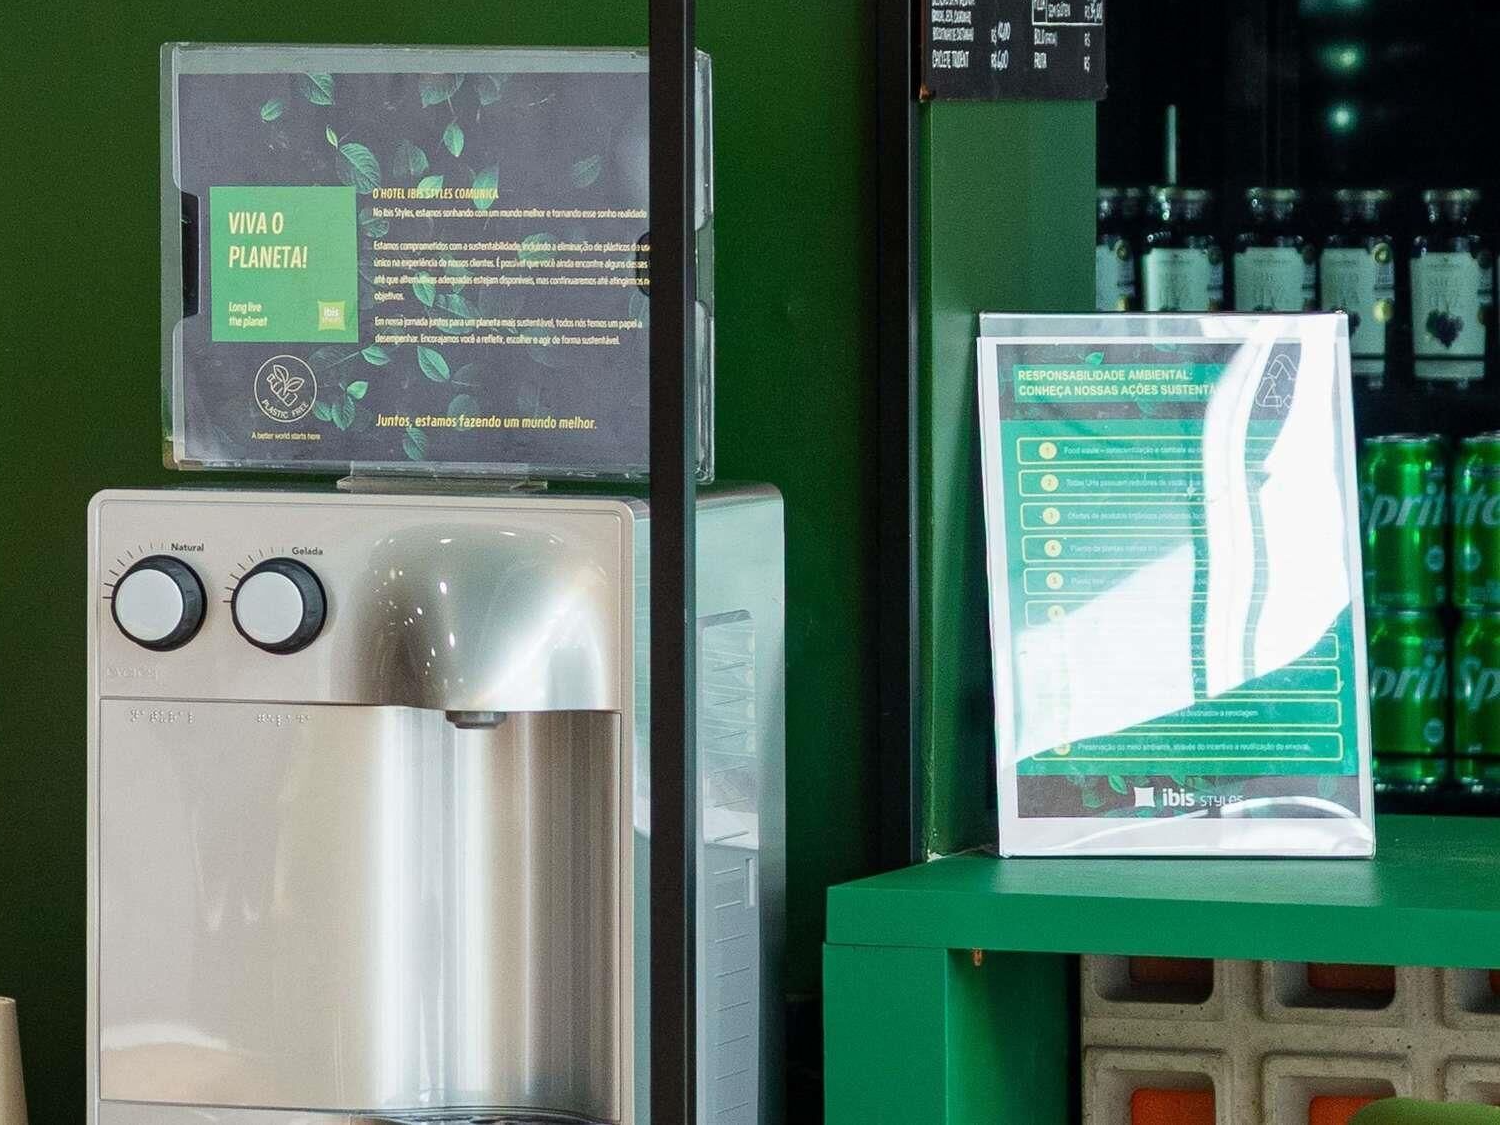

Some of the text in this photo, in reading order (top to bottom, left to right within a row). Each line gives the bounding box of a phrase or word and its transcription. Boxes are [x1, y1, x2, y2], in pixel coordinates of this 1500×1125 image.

[380, 188, 405, 199] HOTEL
[454, 188, 499, 200] COMUNICA
[372, 209, 383, 218] No
[415, 209, 442, 218] estamos
[442, 209, 475, 218] sonhando
[475, 210, 489, 218] com
[489, 210, 499, 218] um
[499, 209, 522, 218] mundo
[523, 208, 546, 218] melhor
[596, 209, 617, 218] sonho
[228, 212, 284, 235] VIVA O
[373, 241, 400, 251] Estamos
[400, 241, 449, 255] comprometidos
[449, 243, 463, 251] com
[228, 246, 309, 268] PLANETA!
[526, 260, 540, 270] que
[540, 258, 556, 268] você
[536, 276, 550, 285] mas
[228, 302, 262, 315] Long live
[228, 315, 268, 328] the planet
[404, 316, 429, 328] jornada
[476, 317, 501, 329] planeta
[607, 320, 619, 328] um
[619, 318, 637, 330] papel
[460, 334, 476, 343] você
[1018, 369, 1193, 381] RESPONSABILIDADE AMBIENTAL:
[1019, 383, 1159, 398] CONHEÇA NOSSAS AÇÕES
[261, 399, 289, 419] PLASTIC
[375, 414, 597, 429] Juntos, estamos fazendo um mundo melhor.
[171, 544, 204, 552] Natural
[292, 547, 324, 555] Gelada
[1162, 788, 1195, 807] ibis
